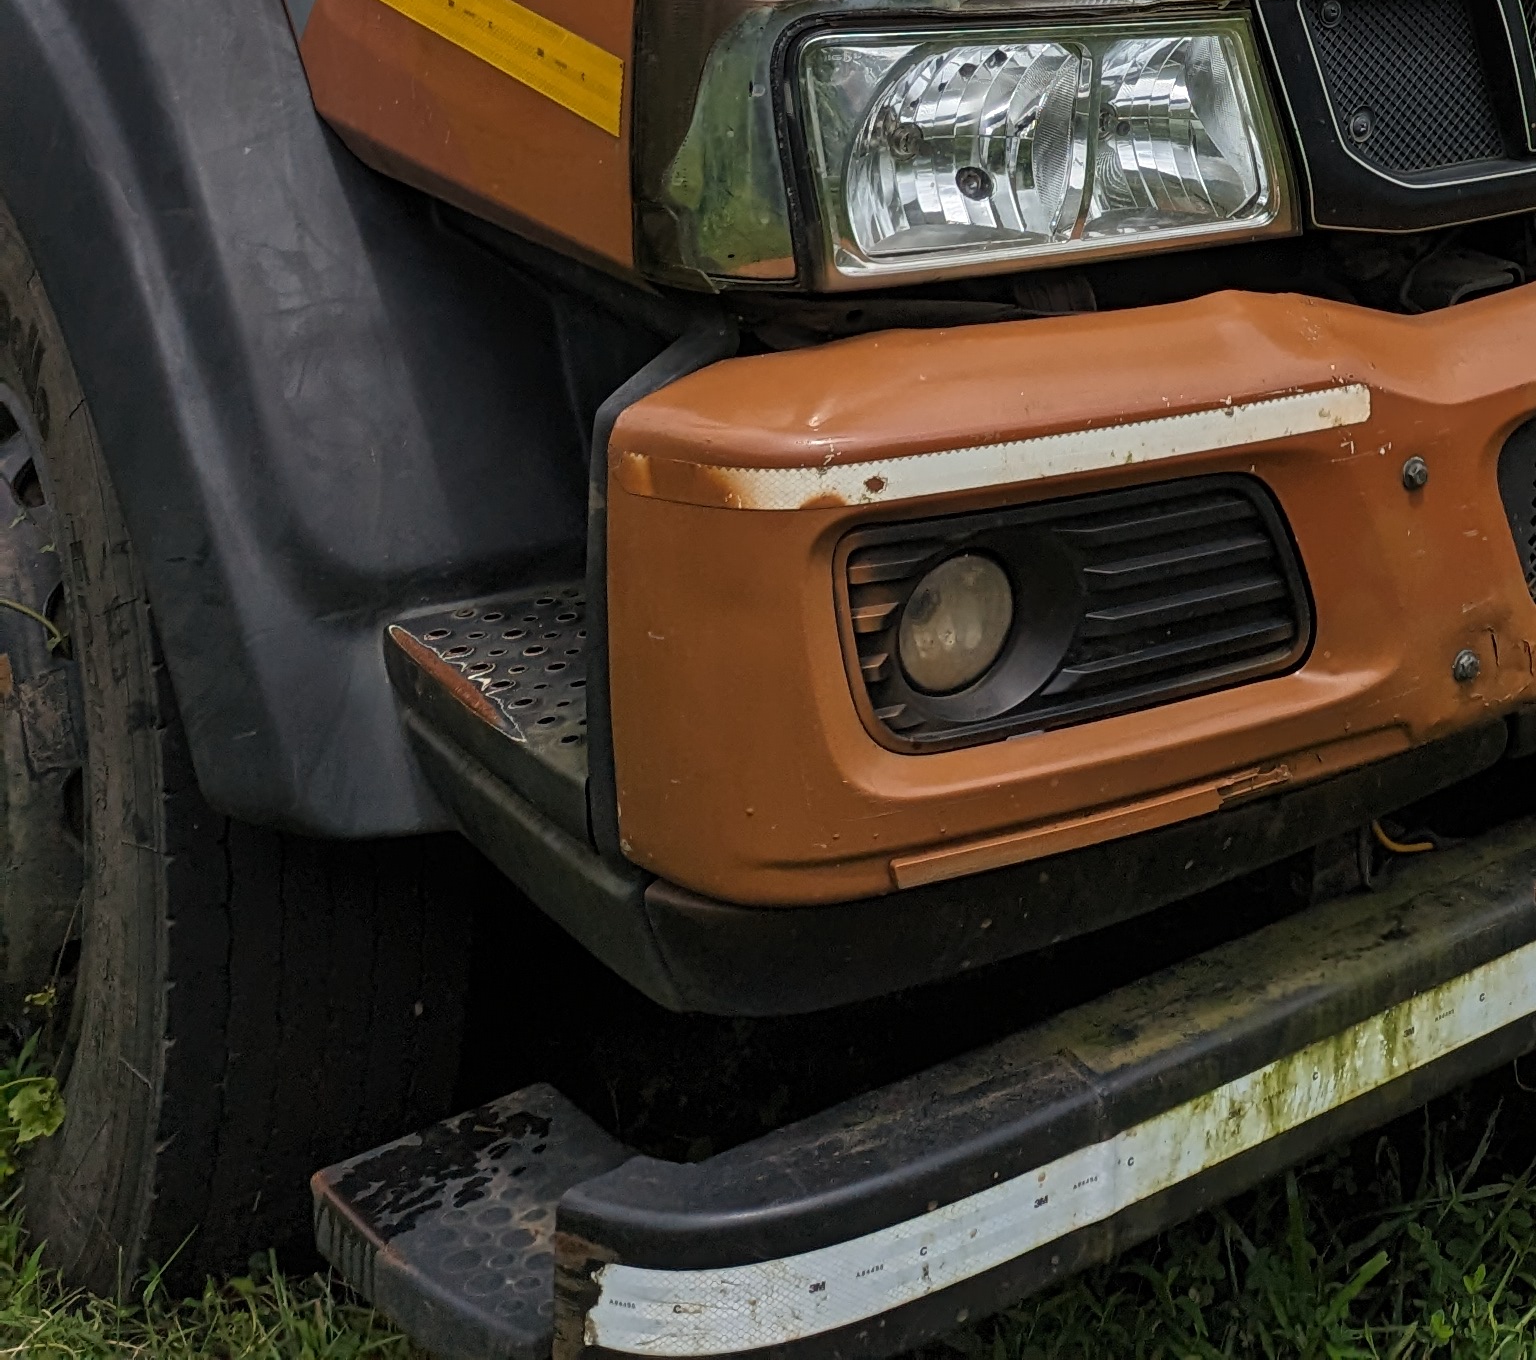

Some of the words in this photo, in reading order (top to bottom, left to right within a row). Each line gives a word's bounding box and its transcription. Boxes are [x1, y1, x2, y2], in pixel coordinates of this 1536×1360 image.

[808, 1281, 826, 1294] 3M
[919, 1246, 928, 1256] C
[673, 1304, 682, 1314] C
